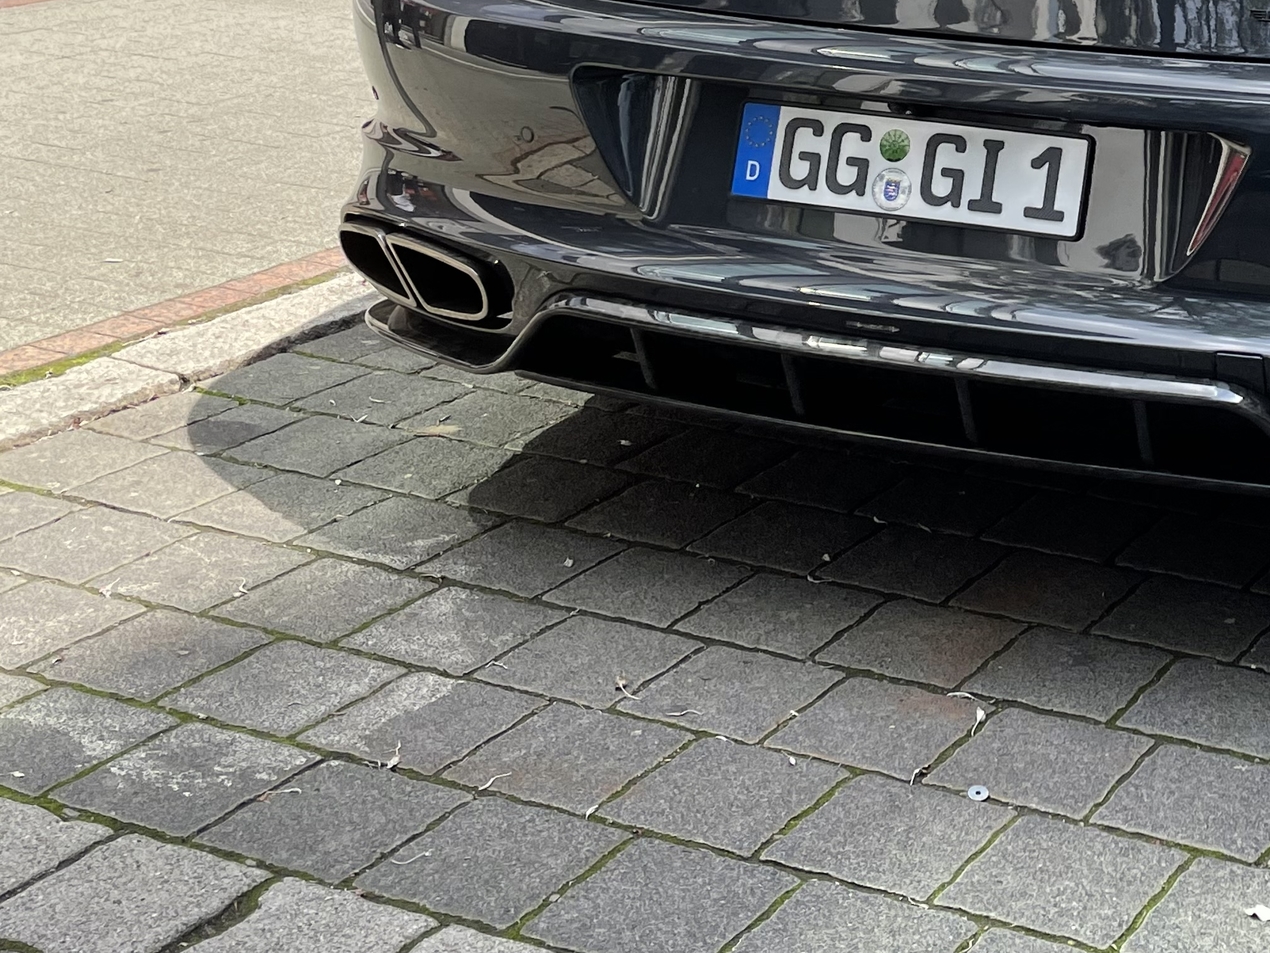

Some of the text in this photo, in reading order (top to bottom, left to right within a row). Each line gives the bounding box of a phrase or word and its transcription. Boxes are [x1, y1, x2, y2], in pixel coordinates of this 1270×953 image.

[745, 160, 760, 181] D
[778, 117, 1065, 222] GG GI 1
